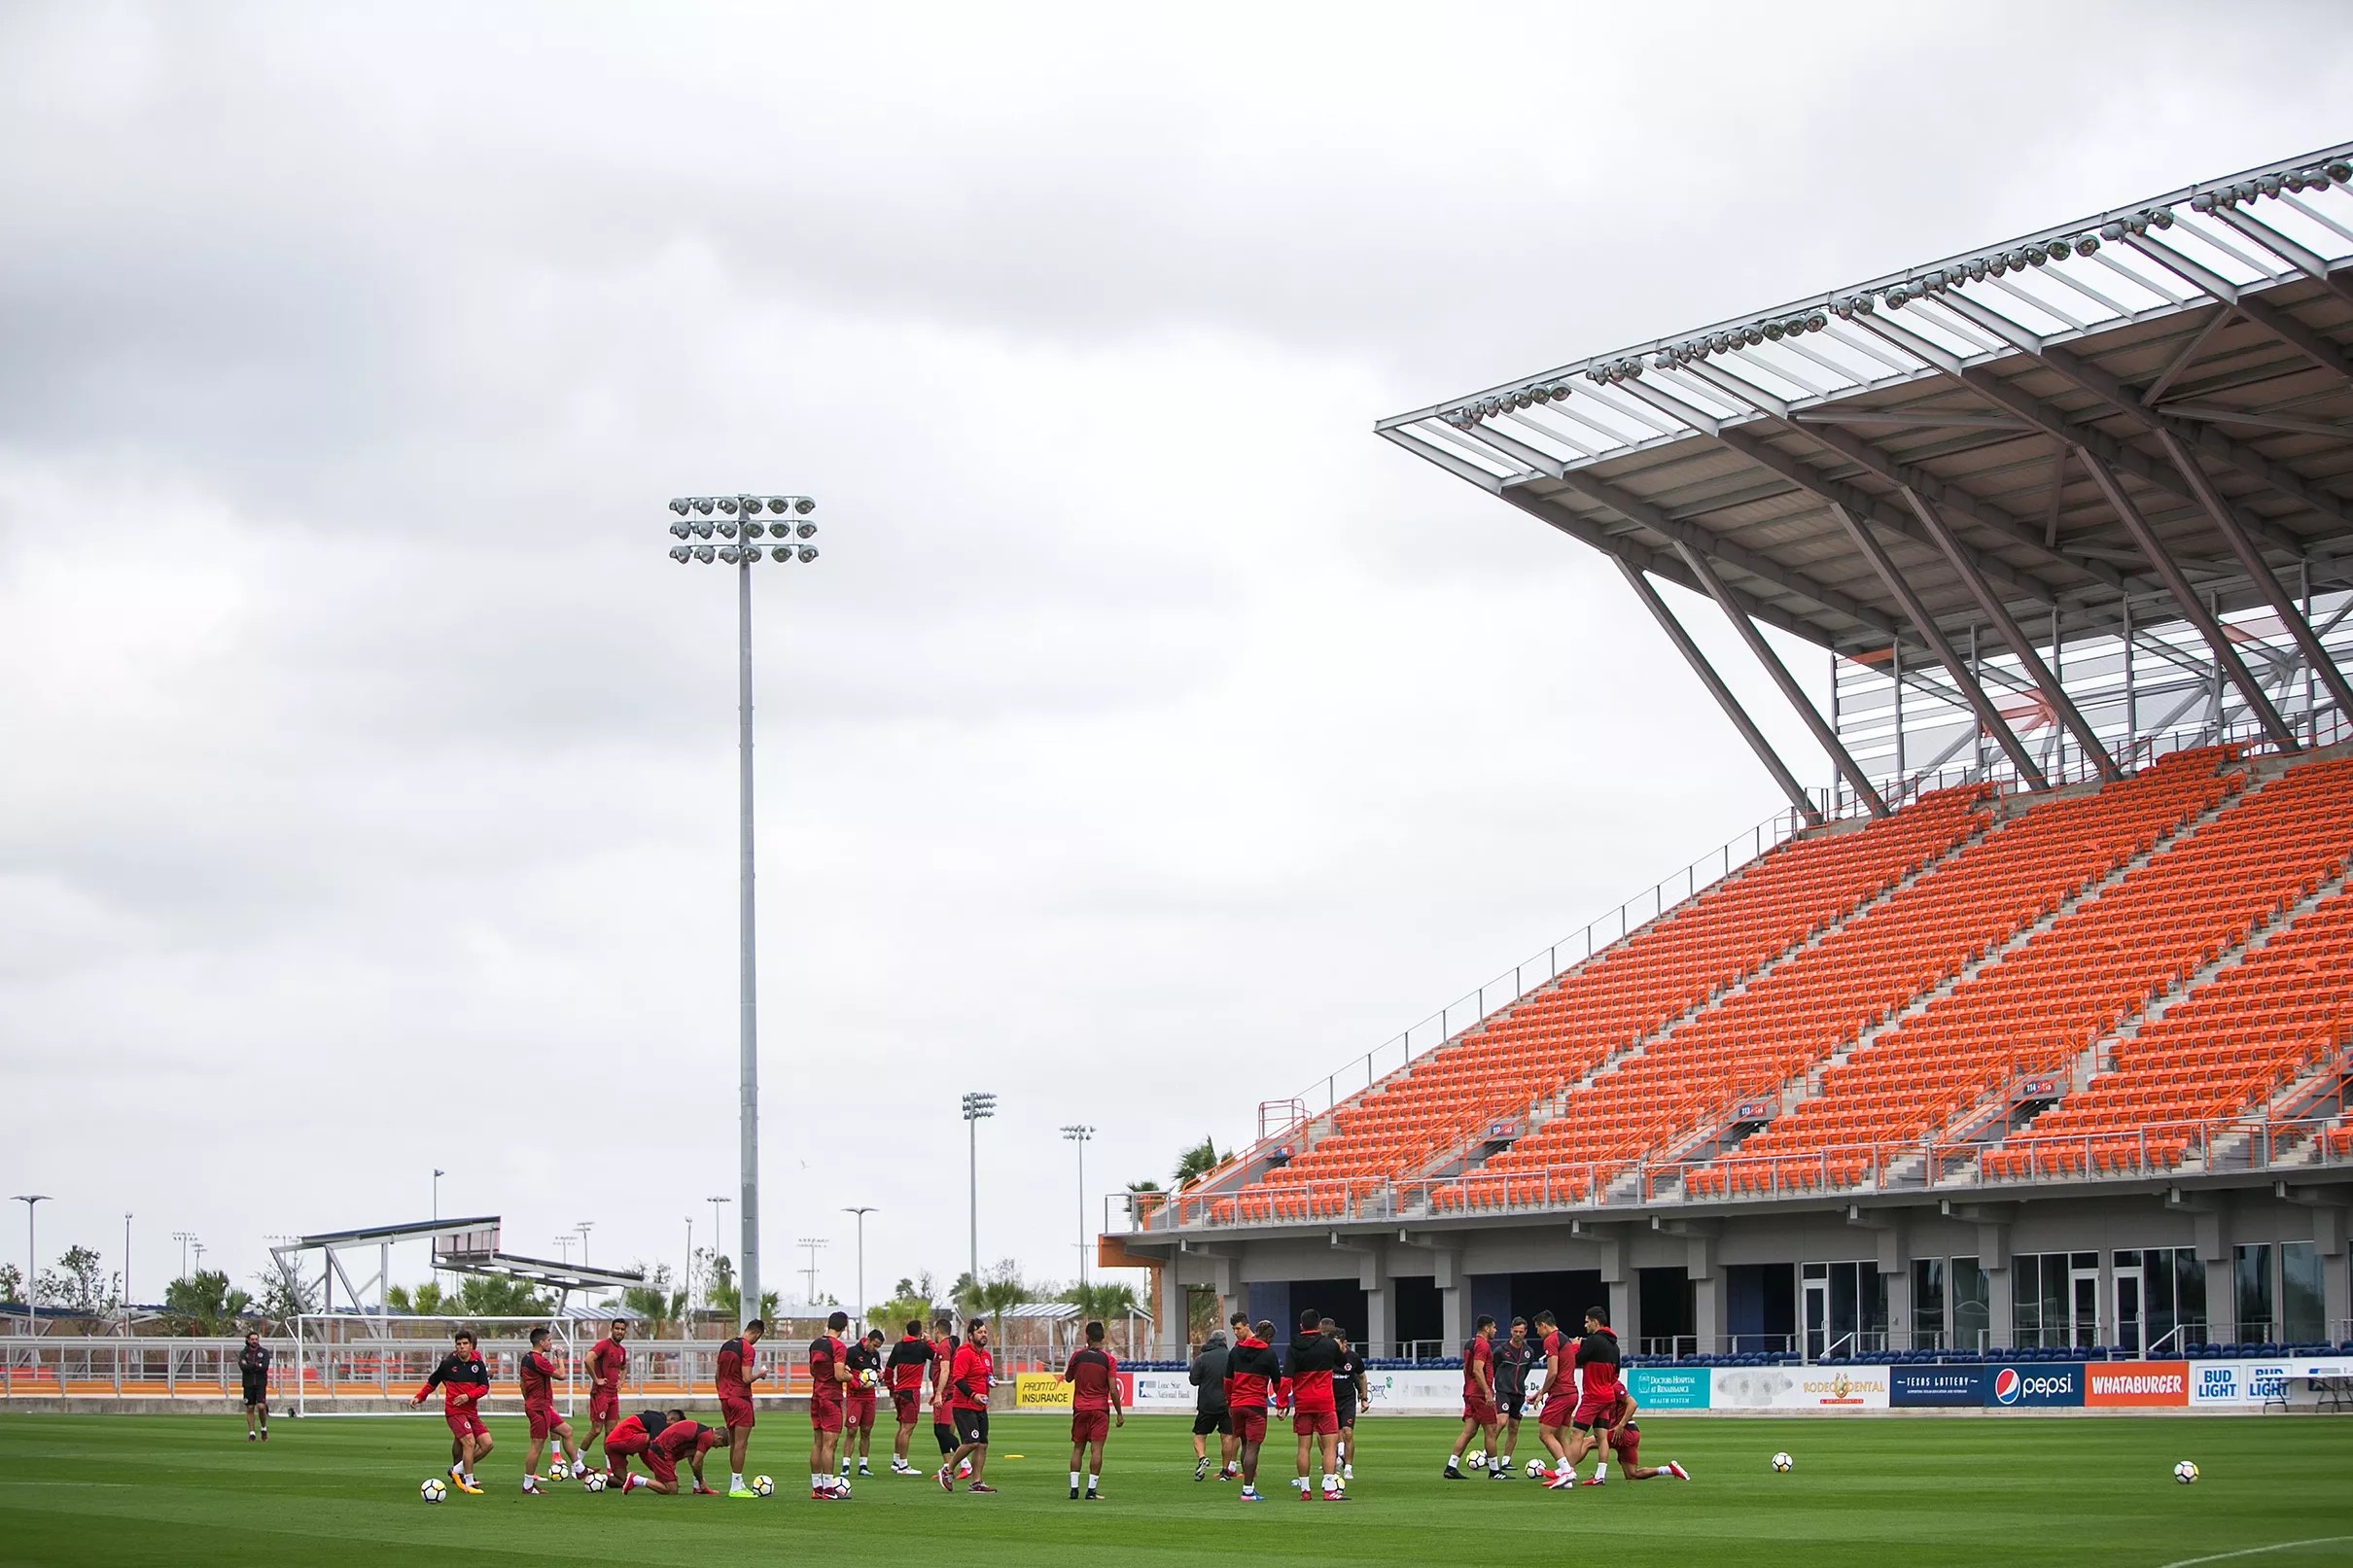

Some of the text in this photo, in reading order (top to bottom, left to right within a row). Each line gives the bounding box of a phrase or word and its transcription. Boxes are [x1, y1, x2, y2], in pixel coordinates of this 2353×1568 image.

[1907, 1376, 1969, 1386] TEXAS LOTTERY
[2204, 1370, 2232, 1382] BUD
[1023, 1381, 1056, 1391] PRONTO
[1157, 1380, 1181, 1389] Lone Star
[1803, 1380, 1885, 1393] RODEO DENTAL
[2022, 1373, 2072, 1398] pepsi
[2091, 1376, 2182, 1394] WHATABURGER
[2198, 1383, 2236, 1397] LIGHT
[2249, 1383, 2289, 1396] LIGHT
[1022, 1393, 1069, 1403] INSURANCE
[1157, 1390, 1176, 1399] National
